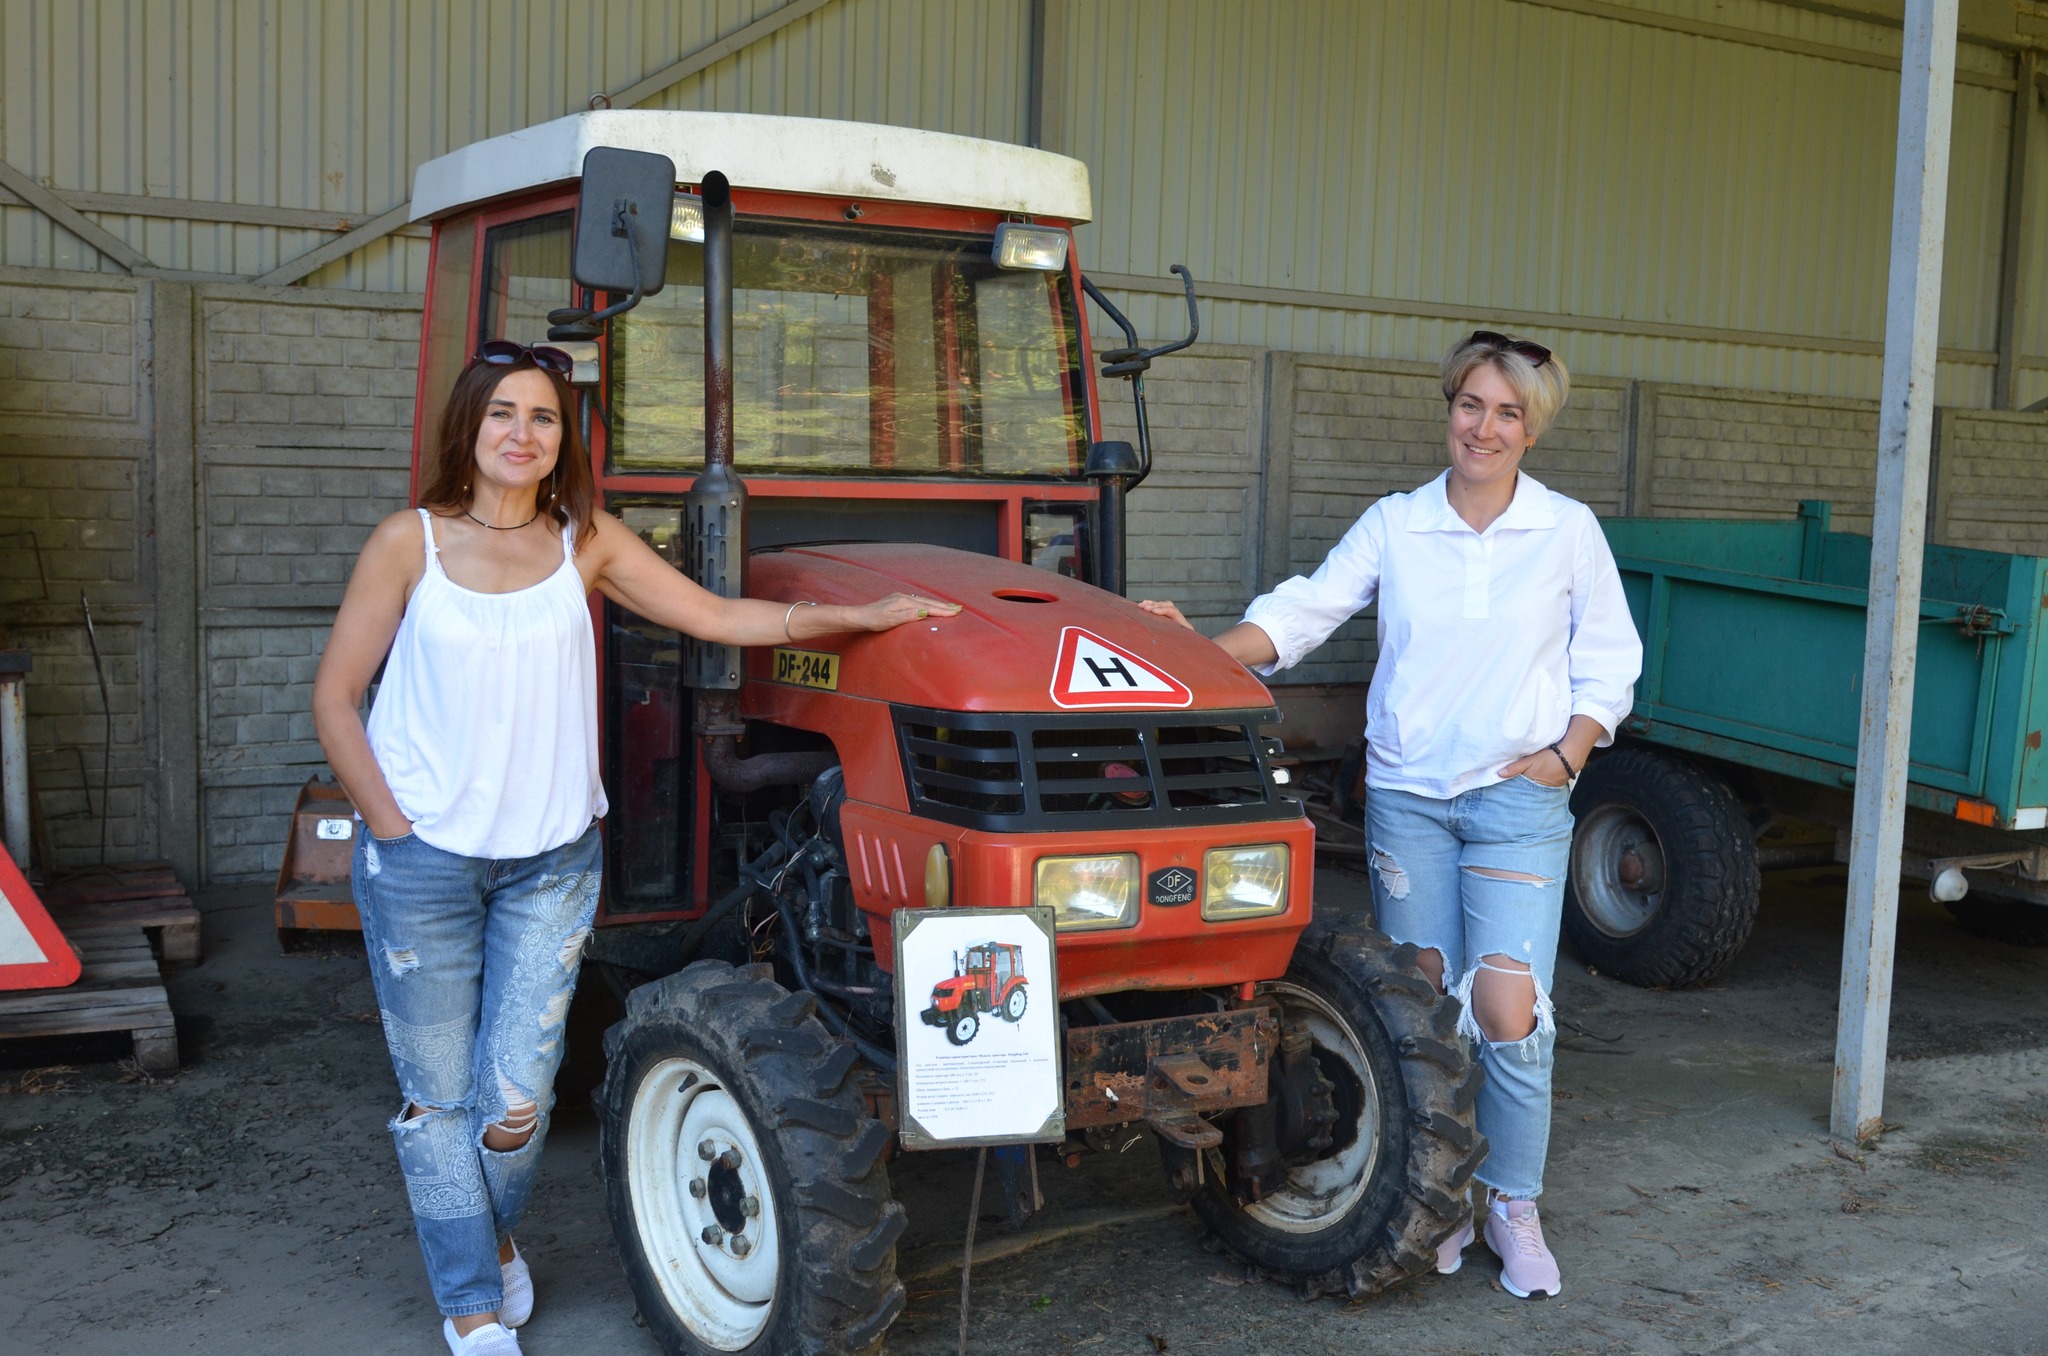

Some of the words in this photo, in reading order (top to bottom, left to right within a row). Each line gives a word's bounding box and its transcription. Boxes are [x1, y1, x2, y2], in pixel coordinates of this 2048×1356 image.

[779, 652, 830, 684] DF-244
[1167, 875, 1181, 888] DF
[1155, 893, 1192, 903] DONGFENG
